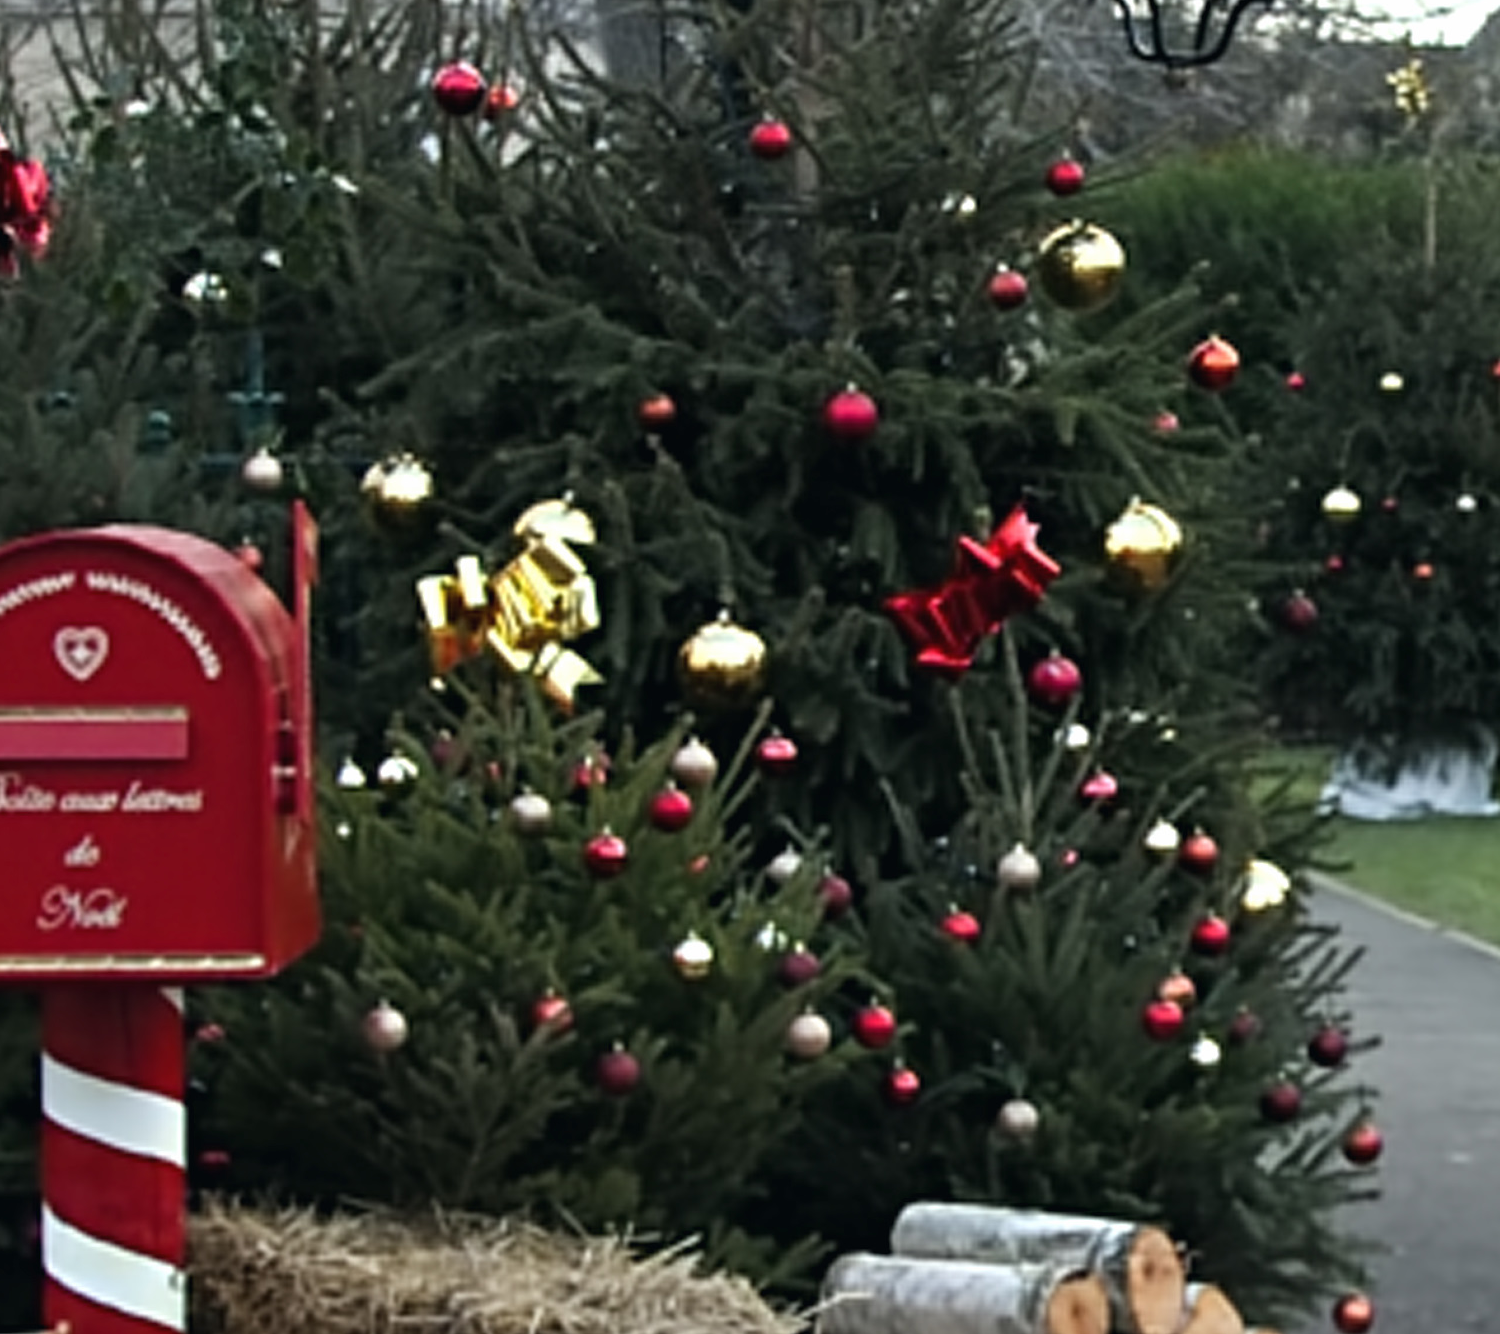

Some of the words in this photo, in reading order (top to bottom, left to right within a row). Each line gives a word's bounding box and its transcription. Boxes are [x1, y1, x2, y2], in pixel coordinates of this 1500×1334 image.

[59, 792, 119, 812] aux
[121, 780, 203, 812] lettres
[63, 834, 101, 867] de
